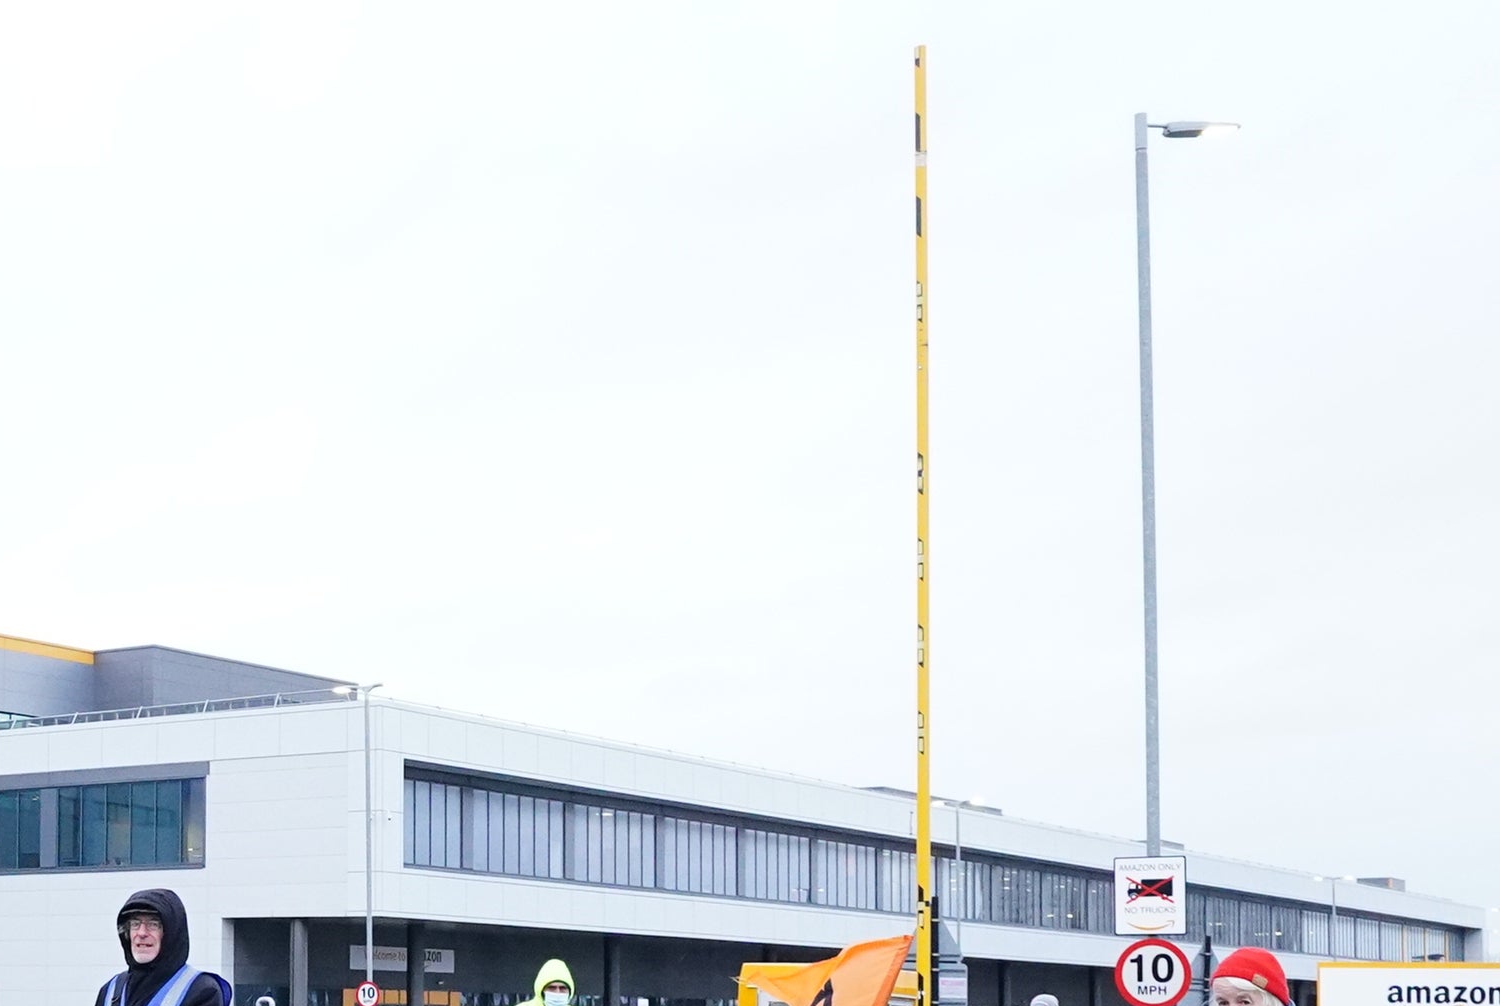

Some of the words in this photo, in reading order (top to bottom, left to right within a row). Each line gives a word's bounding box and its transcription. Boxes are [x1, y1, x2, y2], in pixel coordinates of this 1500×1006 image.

[1118, 863, 1156, 871] AMAZON
[1158, 863, 1182, 871] ONLY
[1140, 906, 1176, 914] TRUCKS
[1129, 953, 1175, 984] 10
[361, 987, 375, 998] 10
[1137, 985, 1168, 996] MPH
[1387, 984, 1500, 1005] amazon
